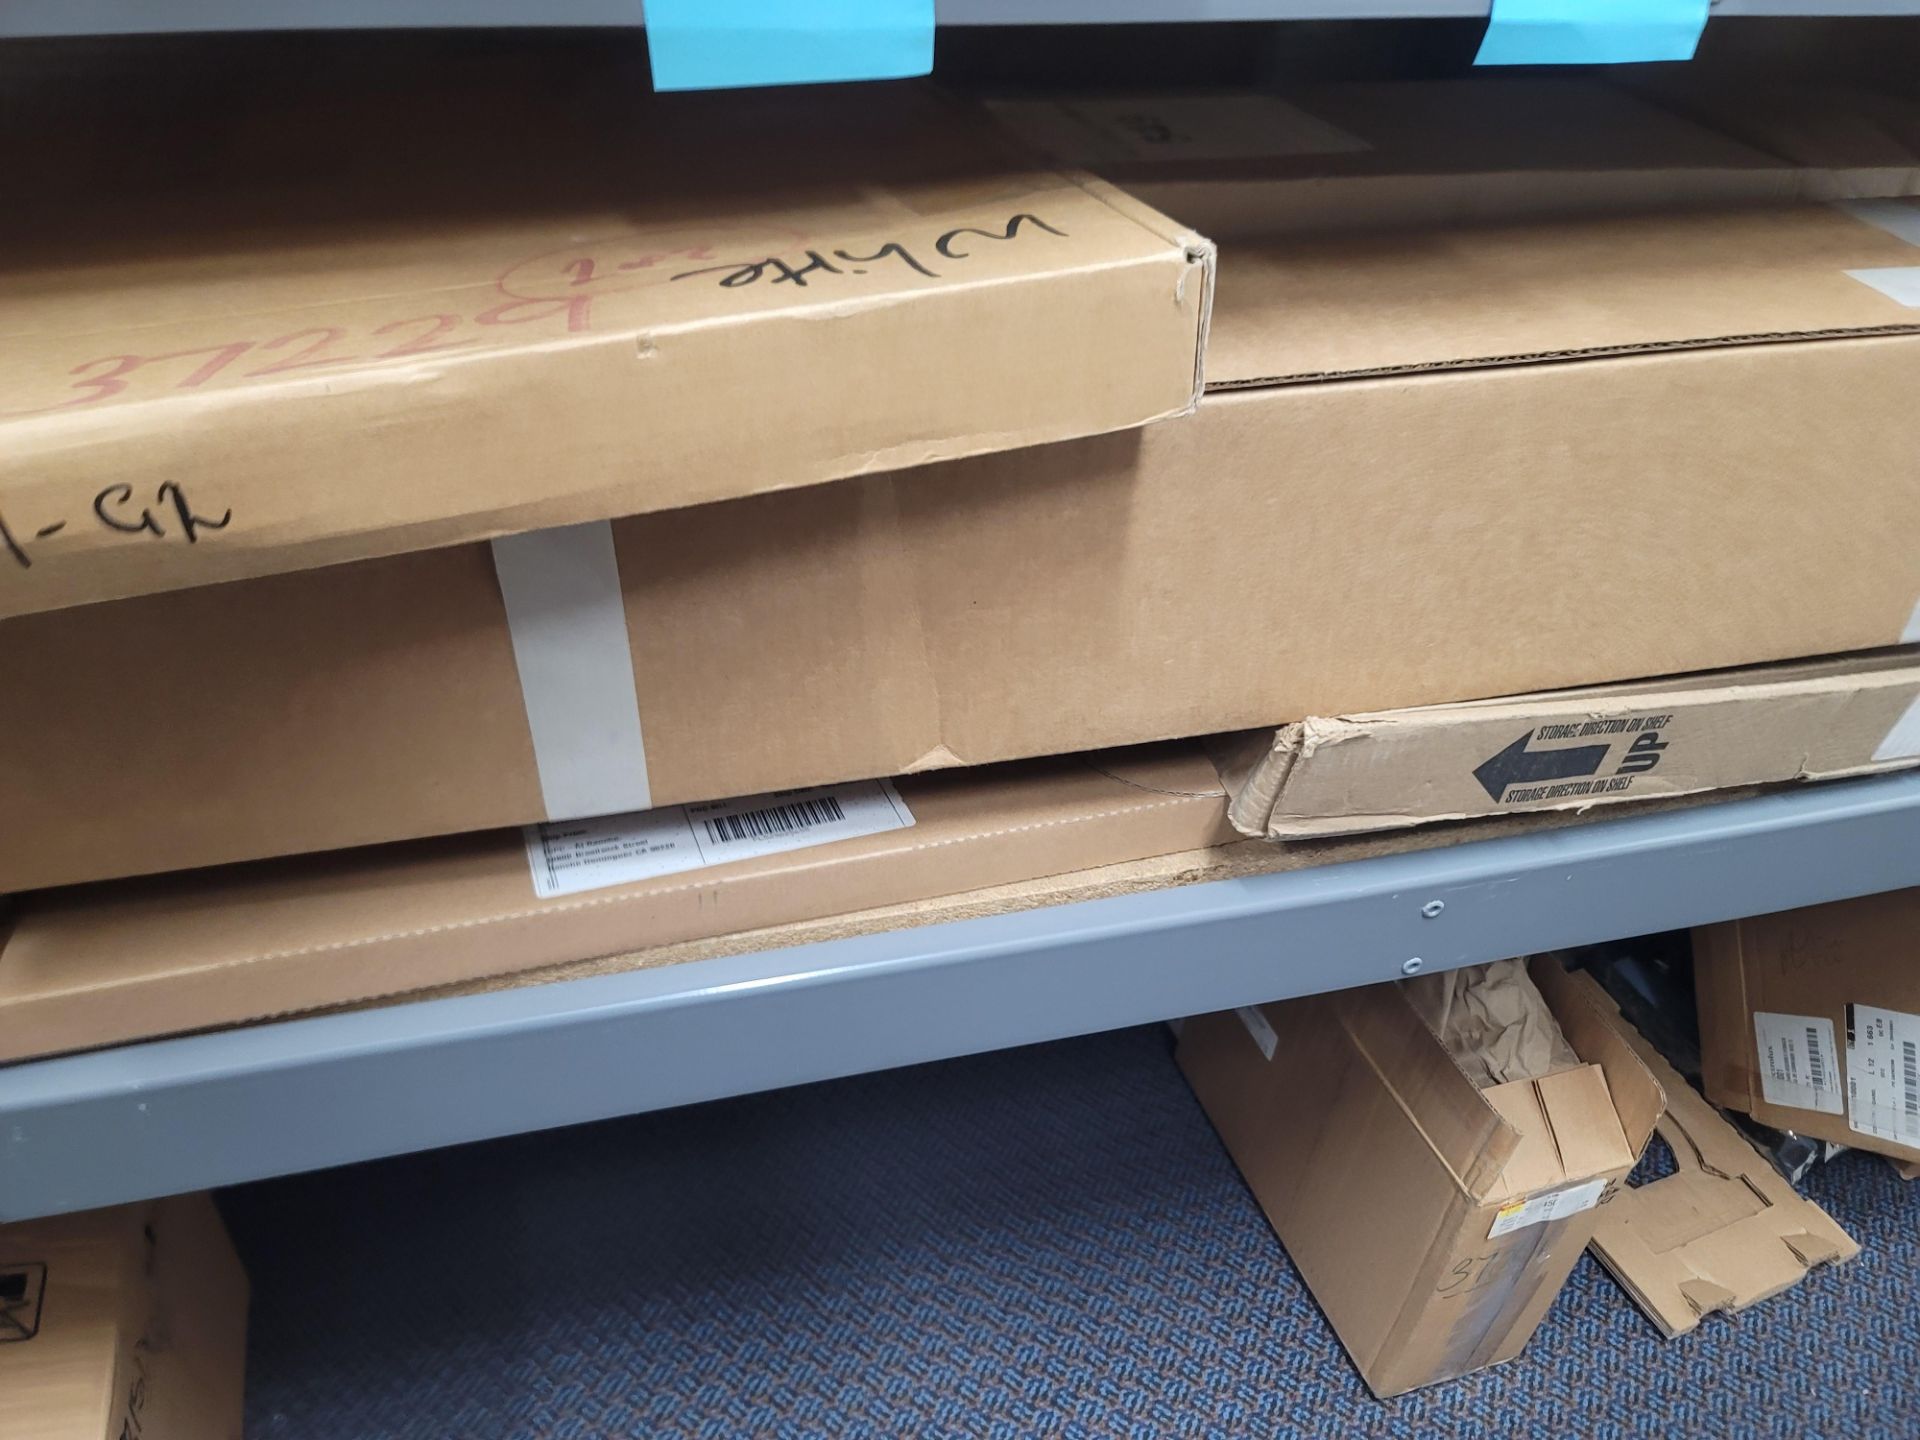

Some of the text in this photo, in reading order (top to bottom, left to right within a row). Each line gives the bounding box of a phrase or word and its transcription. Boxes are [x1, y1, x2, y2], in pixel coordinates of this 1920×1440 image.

[60, 296, 593, 404] 37229
[1537, 714, 1673, 741] STORAGE DIRECTION ON SHELF
[1615, 731, 1669, 775] UP
[1505, 775, 1635, 803] STORAGE DIRECTION ON SHELF
